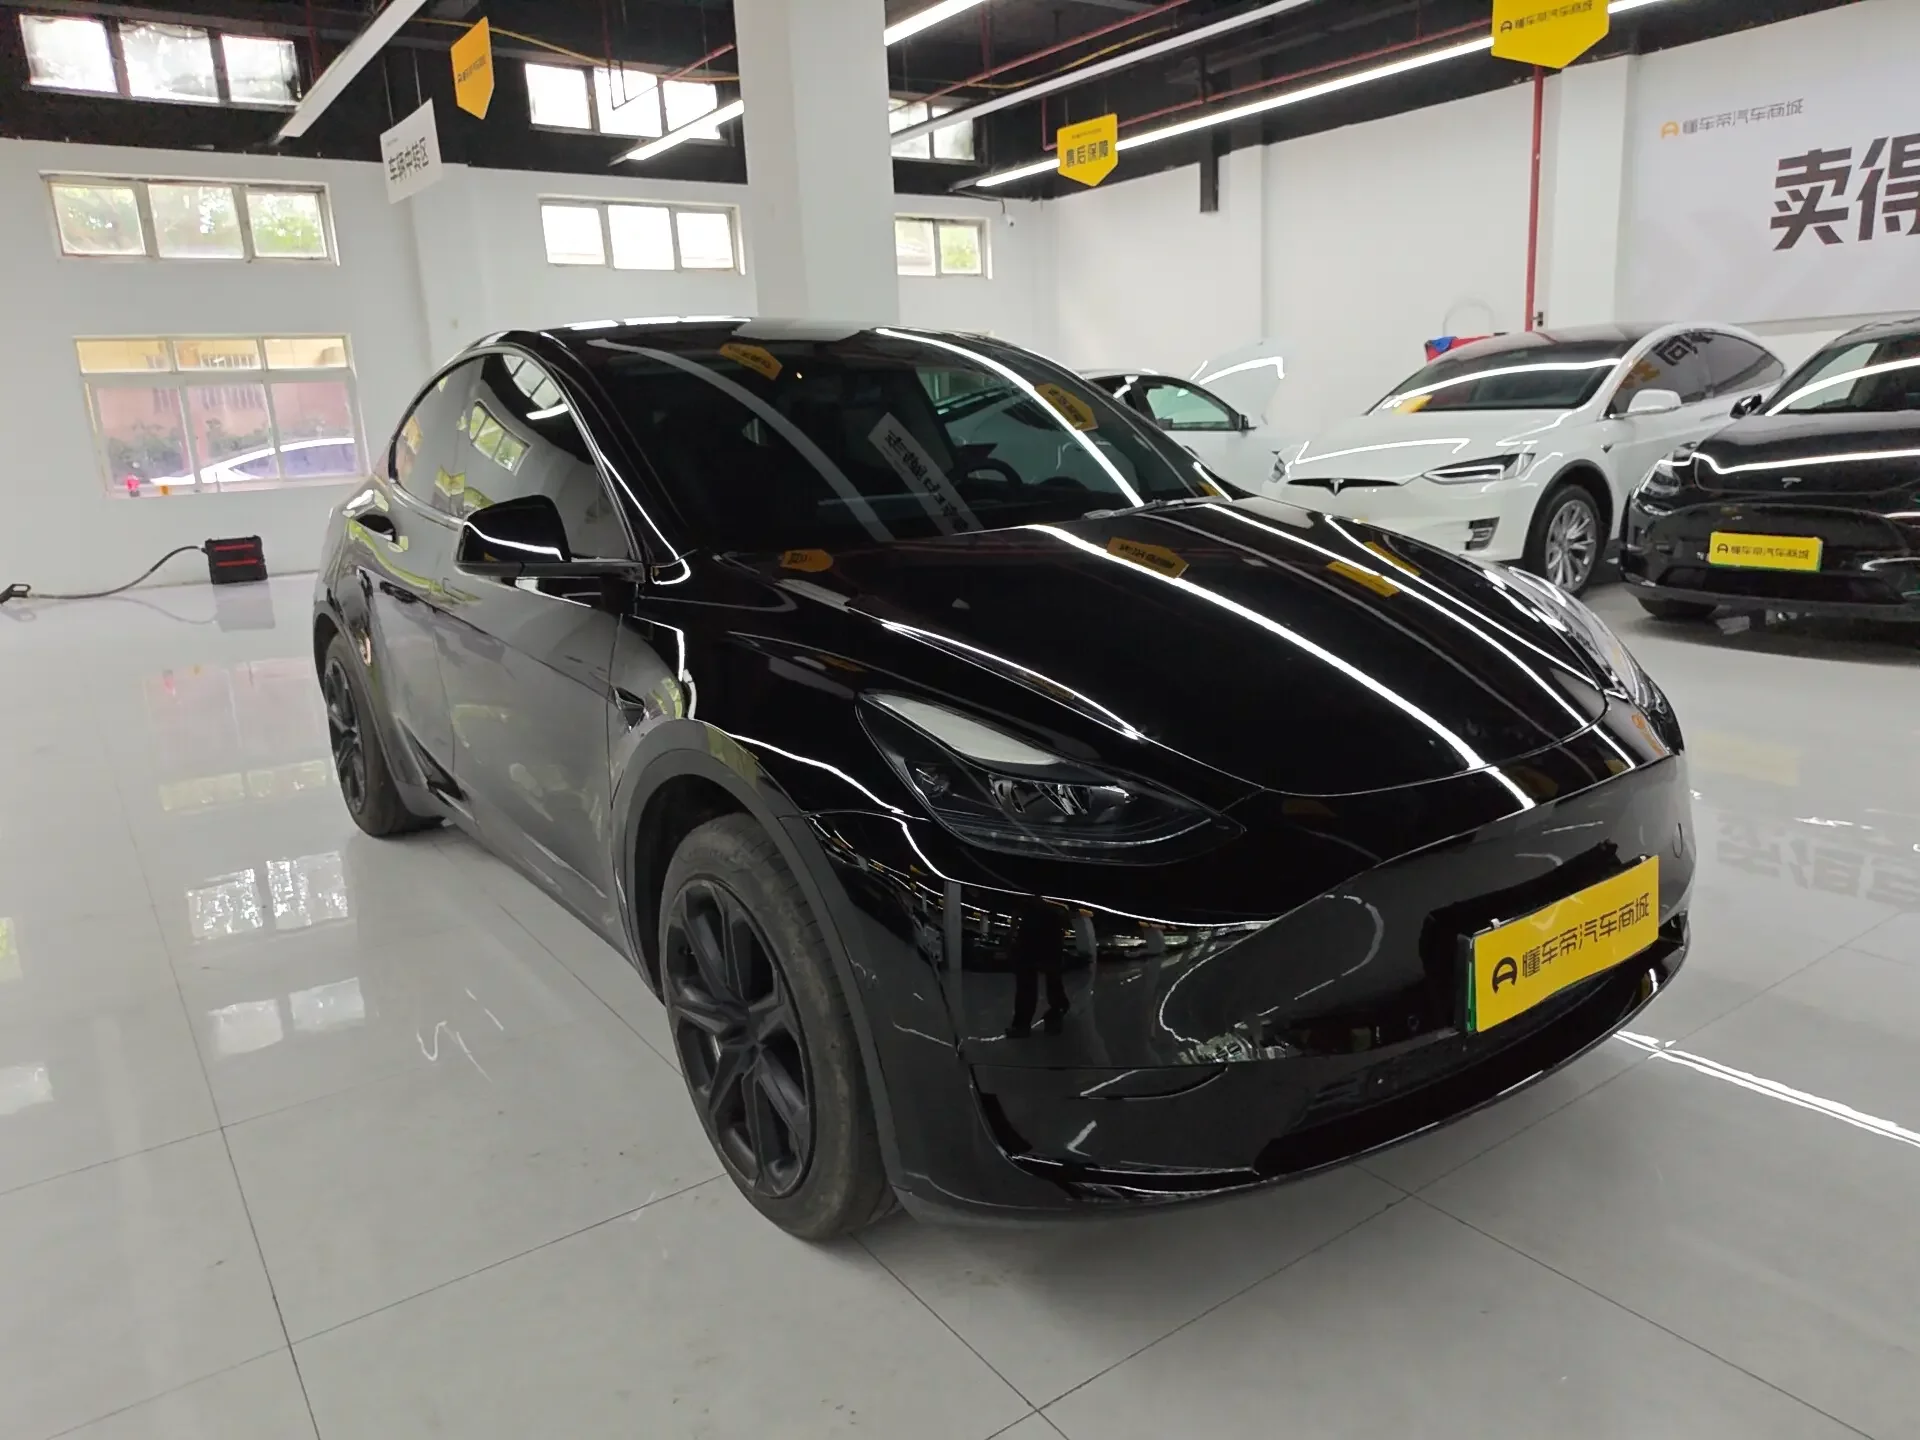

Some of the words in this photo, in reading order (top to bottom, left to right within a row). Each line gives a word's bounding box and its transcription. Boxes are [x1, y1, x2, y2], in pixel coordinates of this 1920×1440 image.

[1769, 132, 1920, 252] 卖得
[1522, 892, 1651, 978] 懂车帝汽车商城
